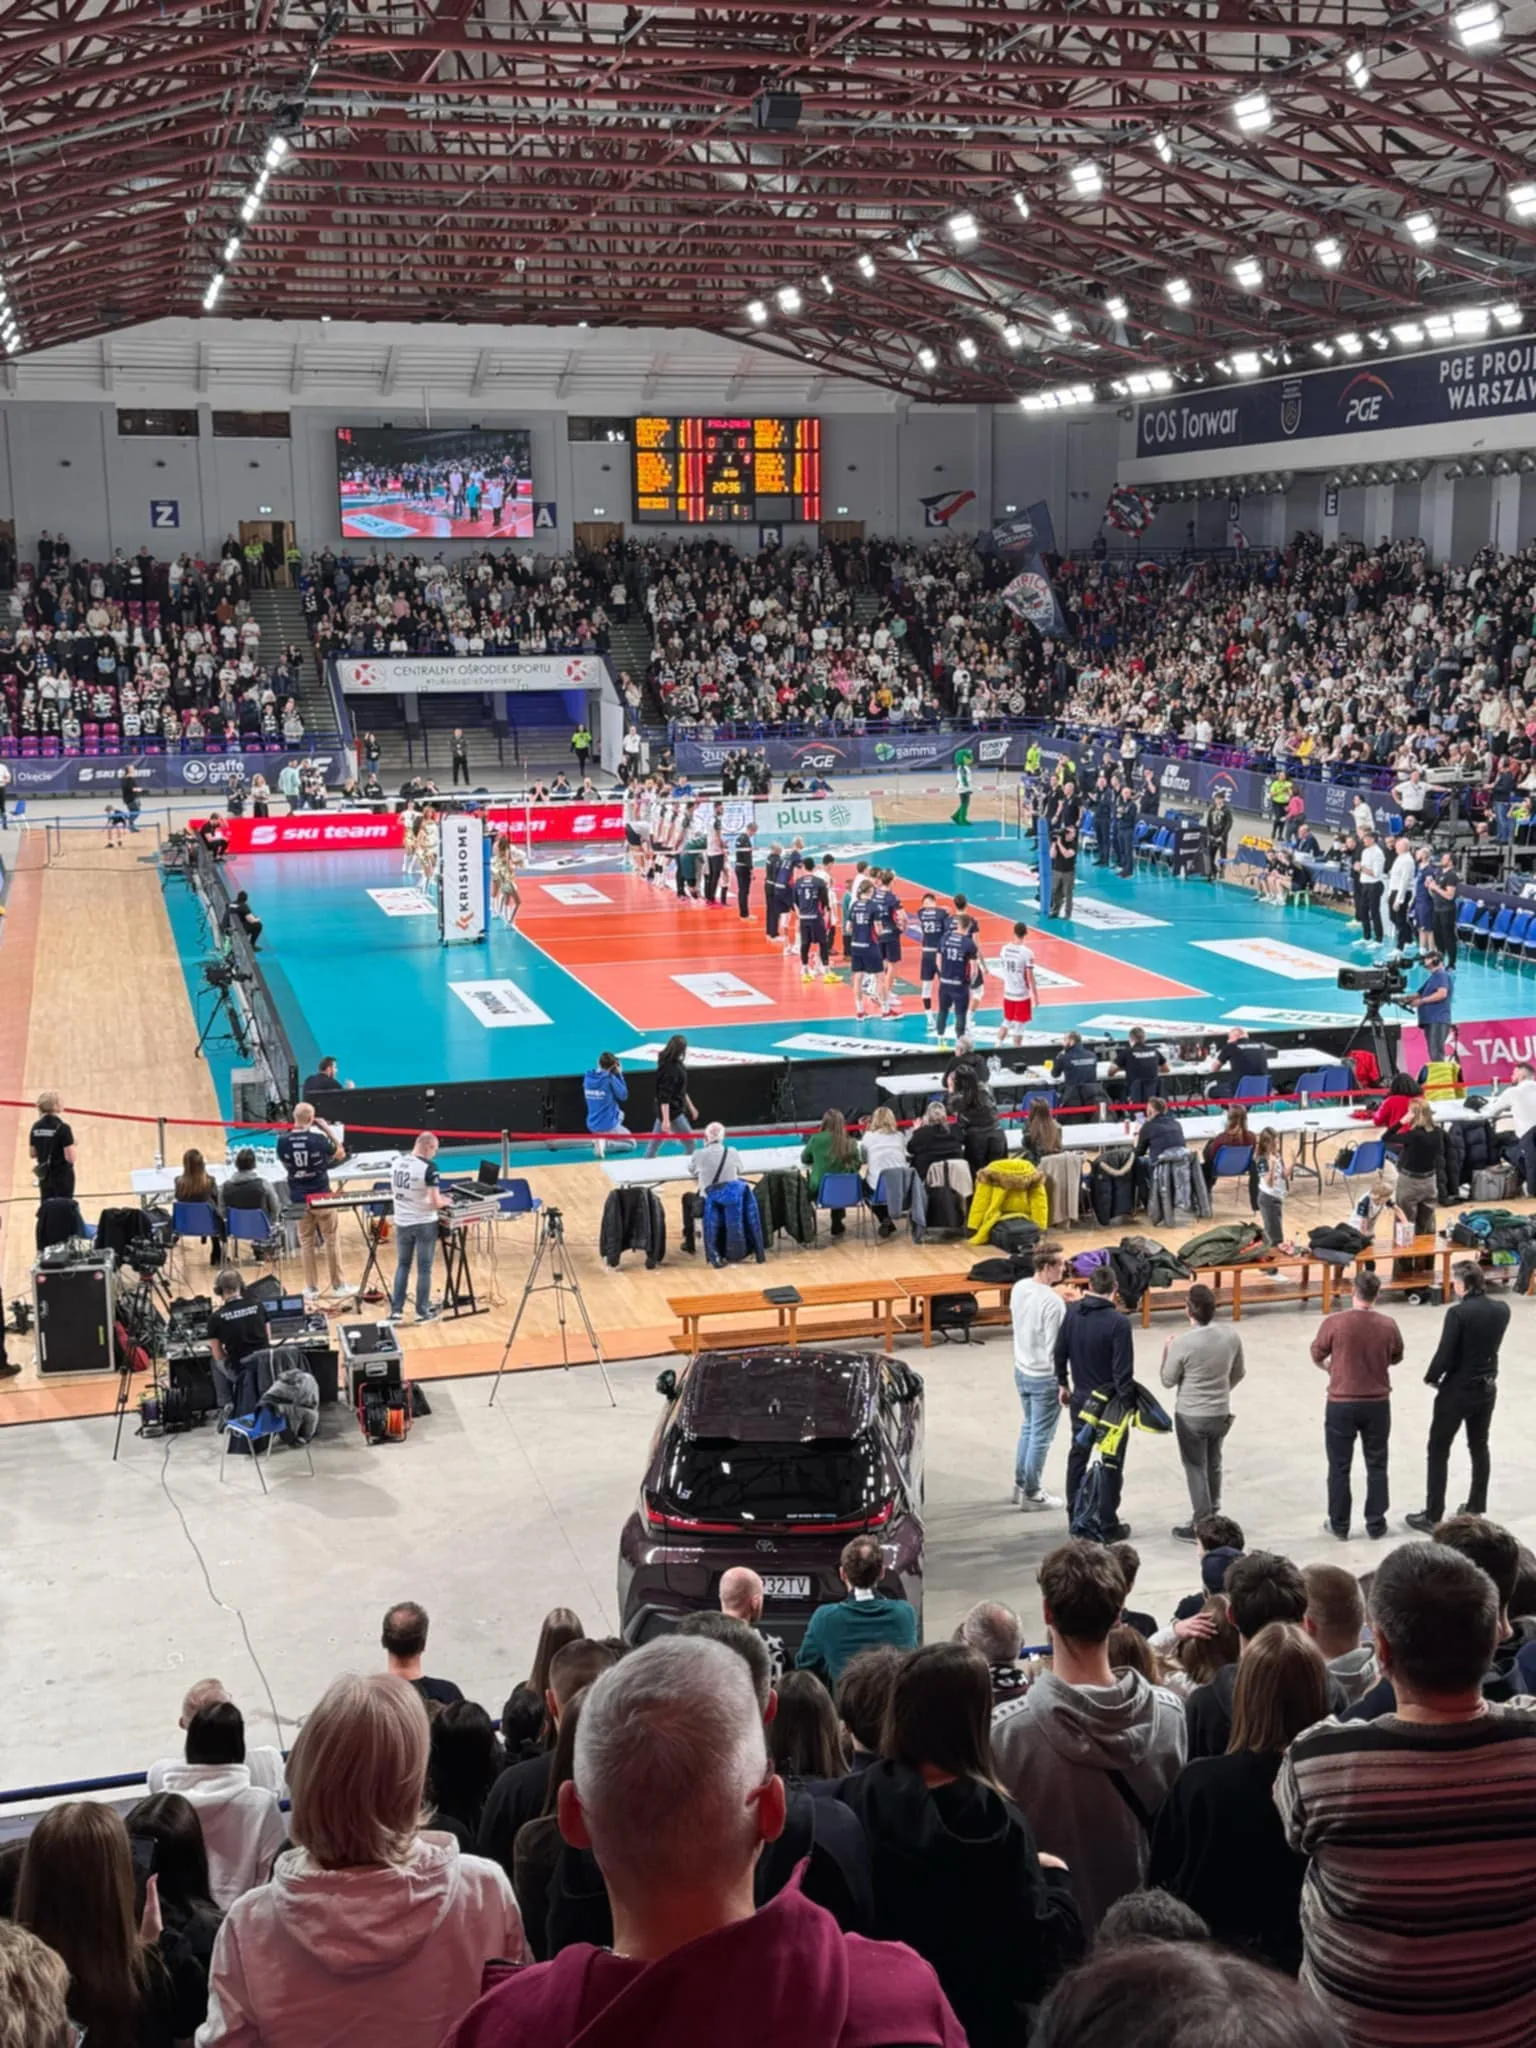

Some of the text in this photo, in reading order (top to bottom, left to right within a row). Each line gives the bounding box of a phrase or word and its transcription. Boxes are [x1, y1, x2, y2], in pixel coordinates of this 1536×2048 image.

[1439, 356, 1475, 384] PGE
[1345, 395, 1383, 424] PGE
[1143, 407, 1239, 444] COS Torwar
[1327, 494, 1337, 514] E
[155, 505, 175, 526] Z
[536, 507, 553, 527] A
[393, 662, 551, 677] CENTRALNY OŚRODEK SPORTU
[801, 755, 835, 768] PGE
[896, 744, 937, 760] gamma
[777, 807, 823, 828] plus
[282, 825, 388, 840] ski team
[457, 825, 469, 912] KRISHOME
[923, 921, 935, 933] 23
[946, 948, 958, 961] 13
[1473, 1035, 1536, 1064] TAU
[293, 1150, 308, 1168] 87
[393, 1169, 410, 1189] 102
